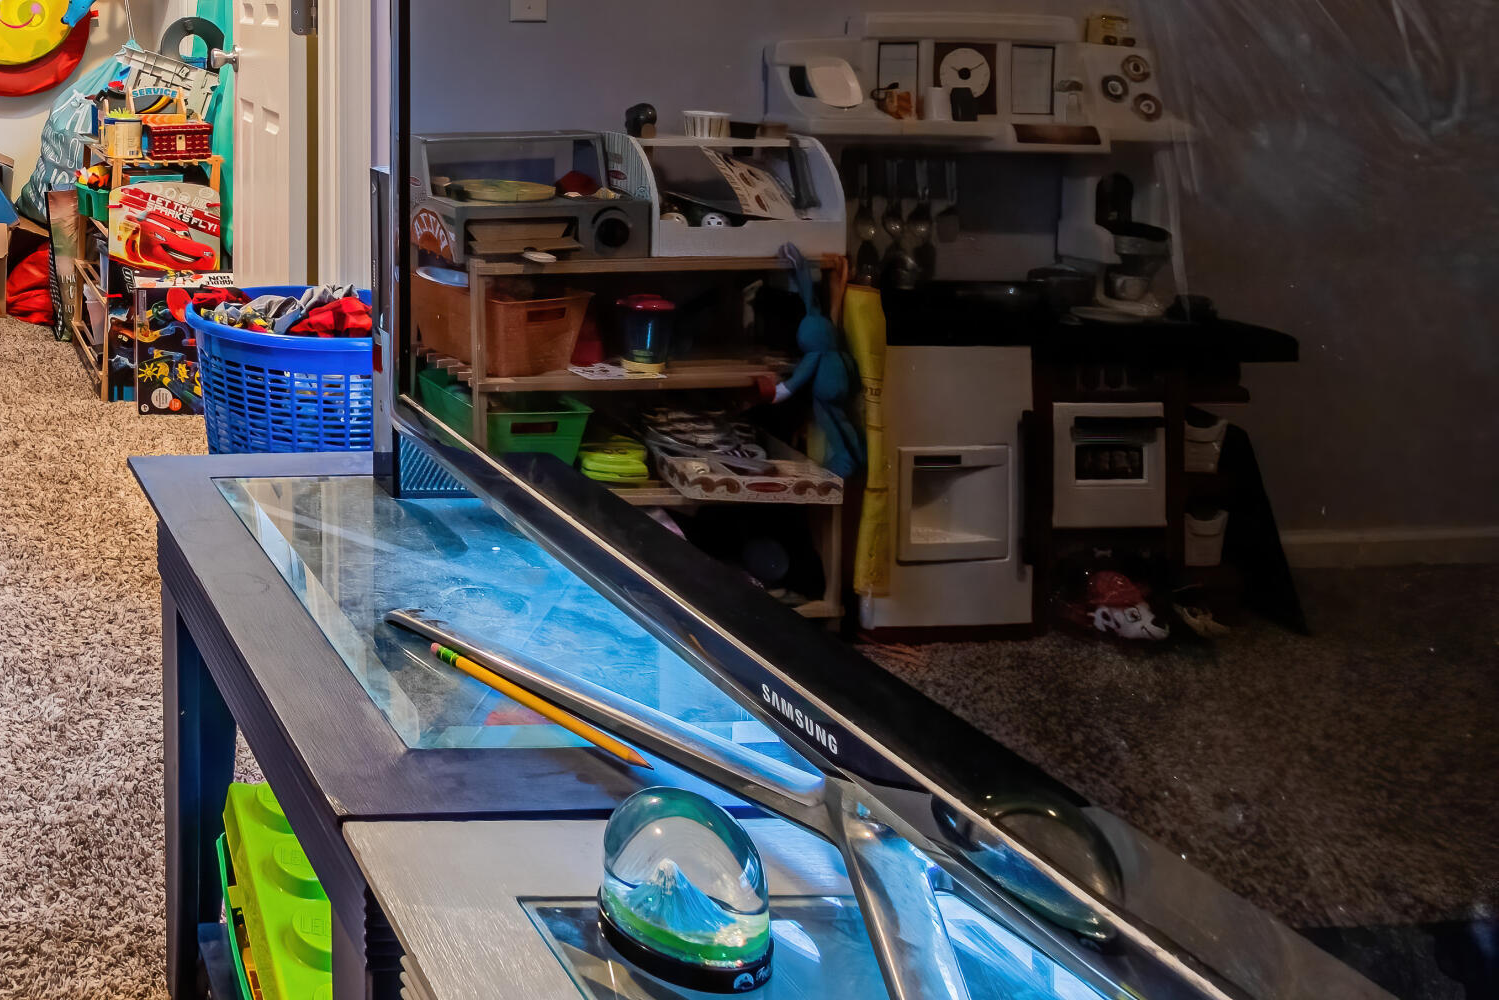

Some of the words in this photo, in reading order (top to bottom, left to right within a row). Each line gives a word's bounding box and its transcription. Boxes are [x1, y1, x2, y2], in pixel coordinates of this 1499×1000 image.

[131, 87, 178, 98] SERVICE
[146, 202, 190, 224] SPARKS
[190, 216, 217, 232] FLY!
[148, 194, 172, 210] LET
[174, 202, 195, 217] THE
[761, 683, 839, 755] SAMSUNG
